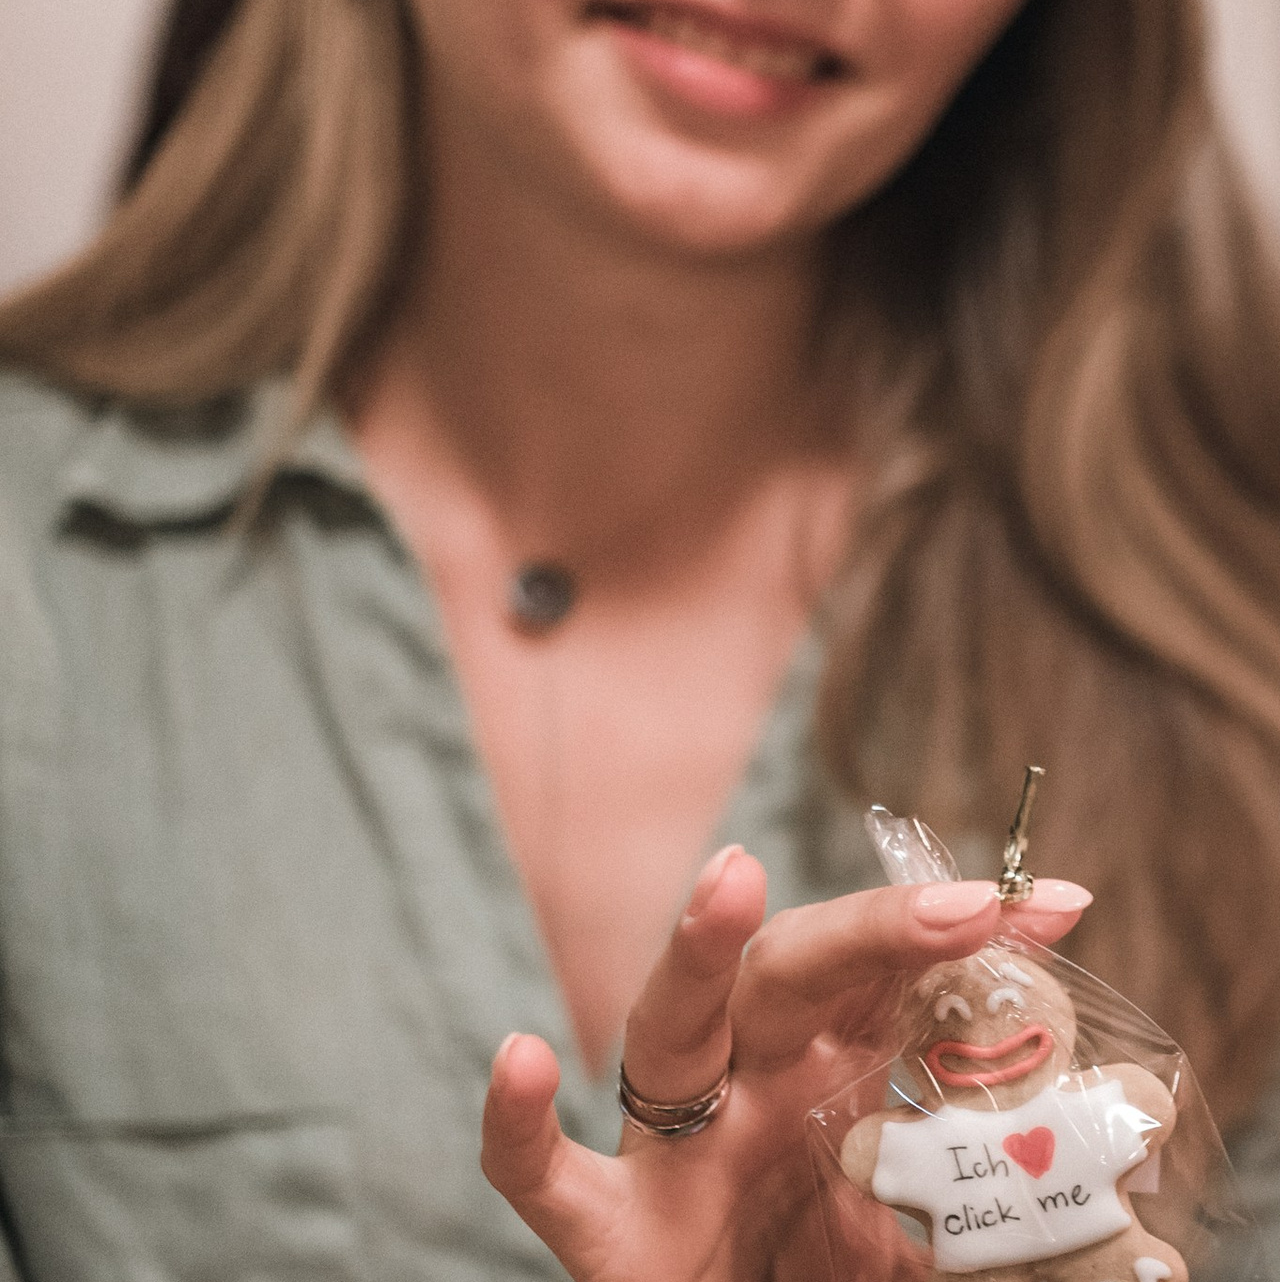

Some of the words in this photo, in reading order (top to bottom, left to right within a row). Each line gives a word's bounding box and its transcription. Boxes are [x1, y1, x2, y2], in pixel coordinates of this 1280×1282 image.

[946, 1143, 1010, 1182] Ich
[944, 1197, 1021, 1235] click
[1036, 1184, 1091, 1213] me
